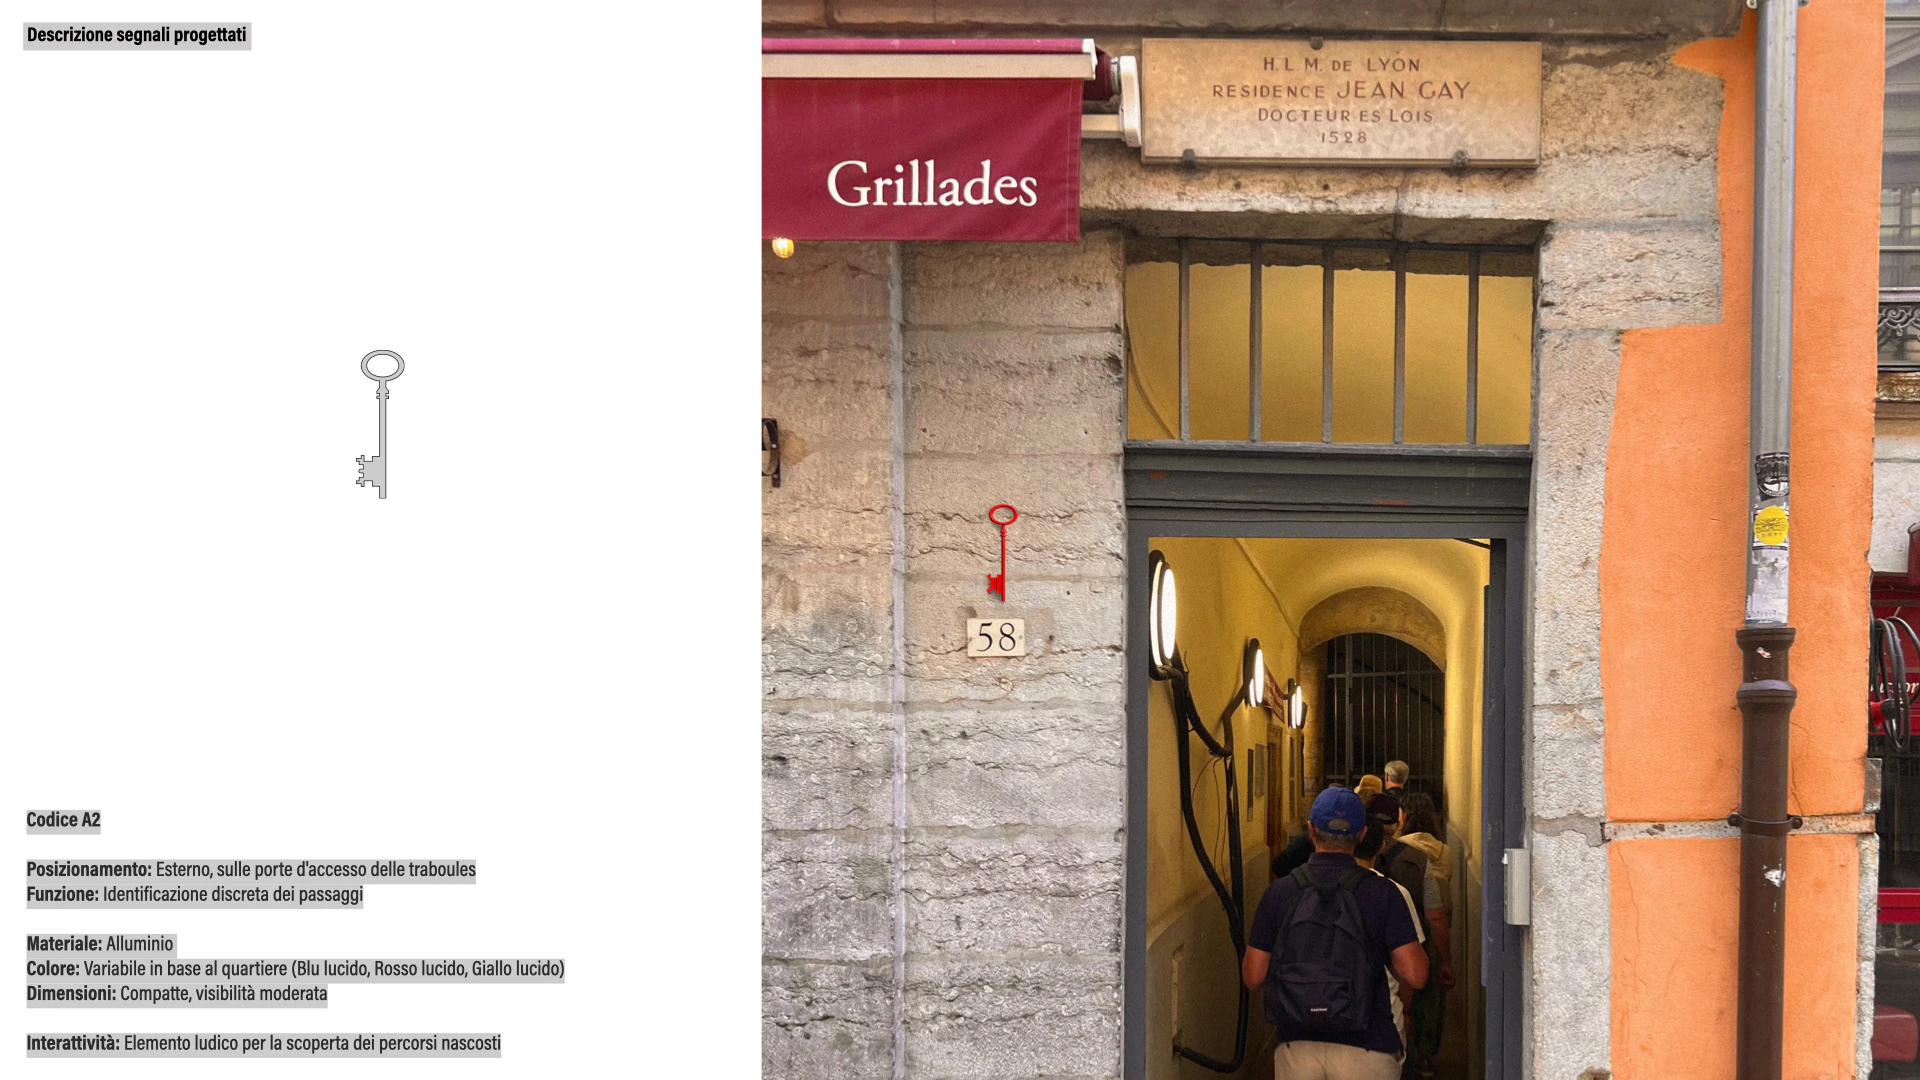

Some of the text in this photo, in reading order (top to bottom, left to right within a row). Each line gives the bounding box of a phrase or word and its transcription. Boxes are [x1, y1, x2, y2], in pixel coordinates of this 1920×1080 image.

[1332, 60, 1352, 72] DE
[1367, 58, 1421, 72] LYON
[1212, 84, 1325, 99] RESIDENCE
[1336, 81, 1405, 99] JEAN
[1258, 107, 1433, 123] DOCTEUR ES LOIS
[1321, 131, 1367, 144] 1528
[827, 158, 1037, 207] Grillades
[976, 622, 1016, 652] 58
